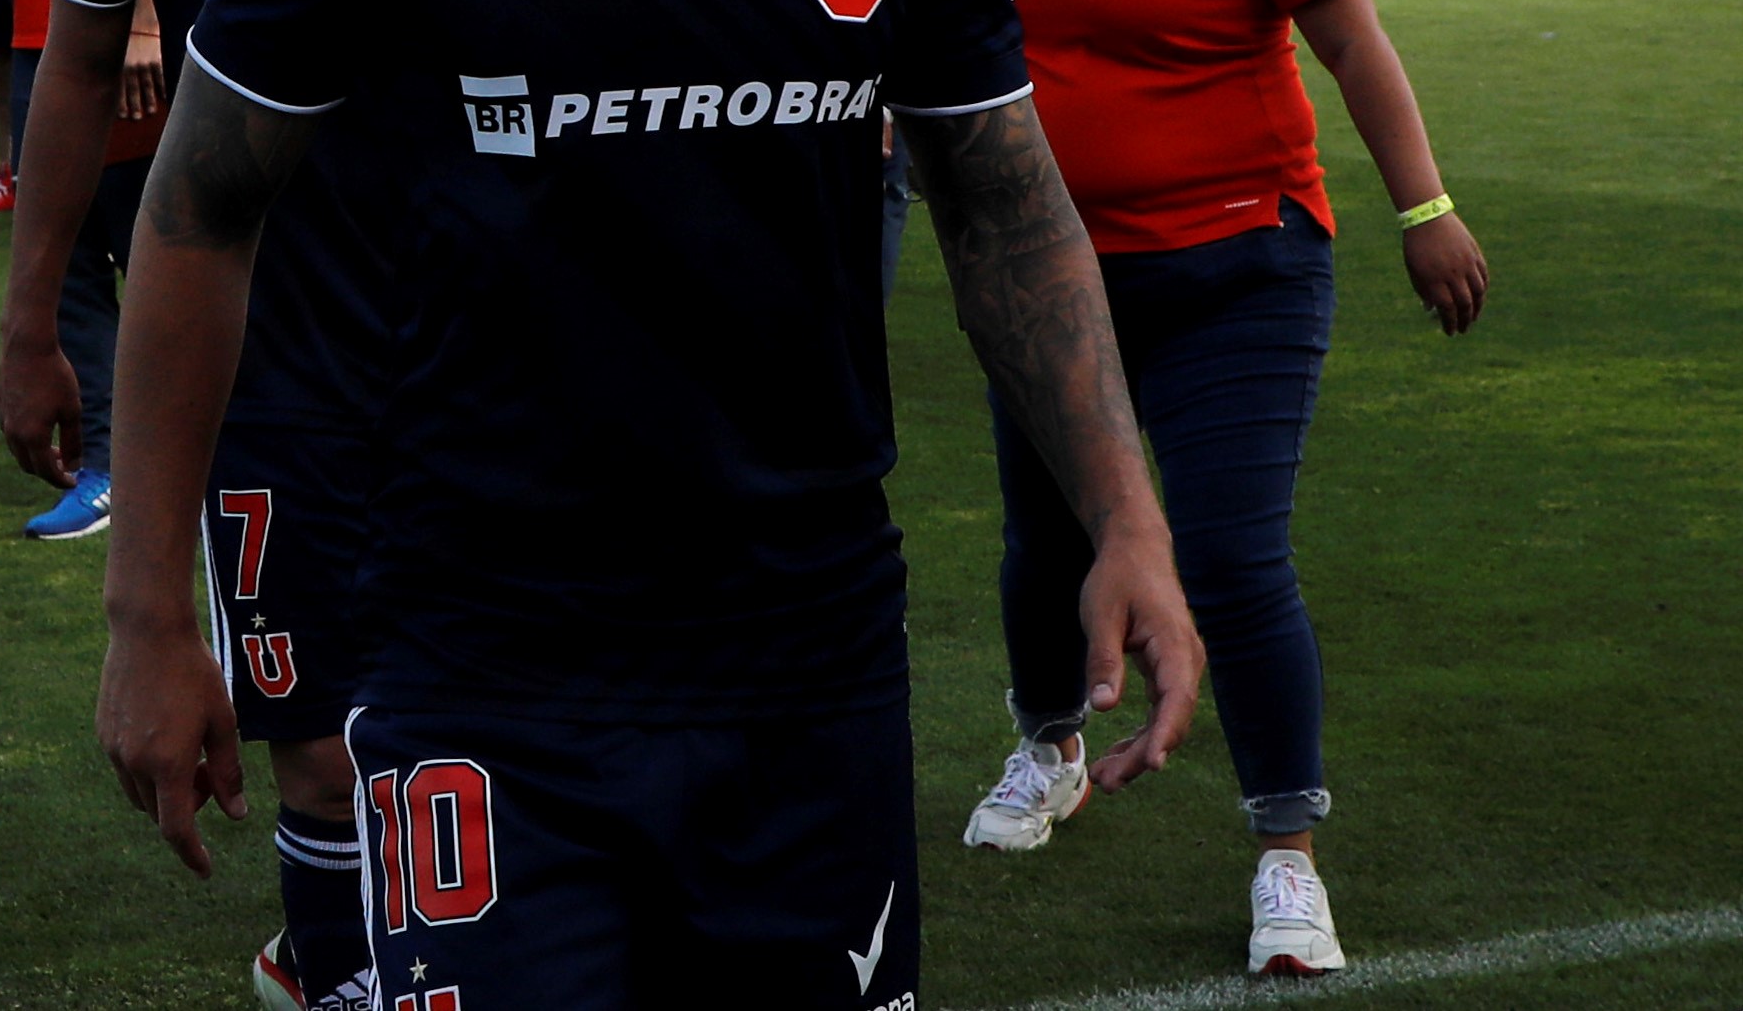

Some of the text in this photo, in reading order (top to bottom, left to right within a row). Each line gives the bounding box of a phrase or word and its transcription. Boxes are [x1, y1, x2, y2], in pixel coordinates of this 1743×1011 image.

[476, 74, 883, 139] BR PETROBRA
[219, 489, 272, 600] 7
[242, 631, 298, 698] U
[369, 758, 498, 935] 10
